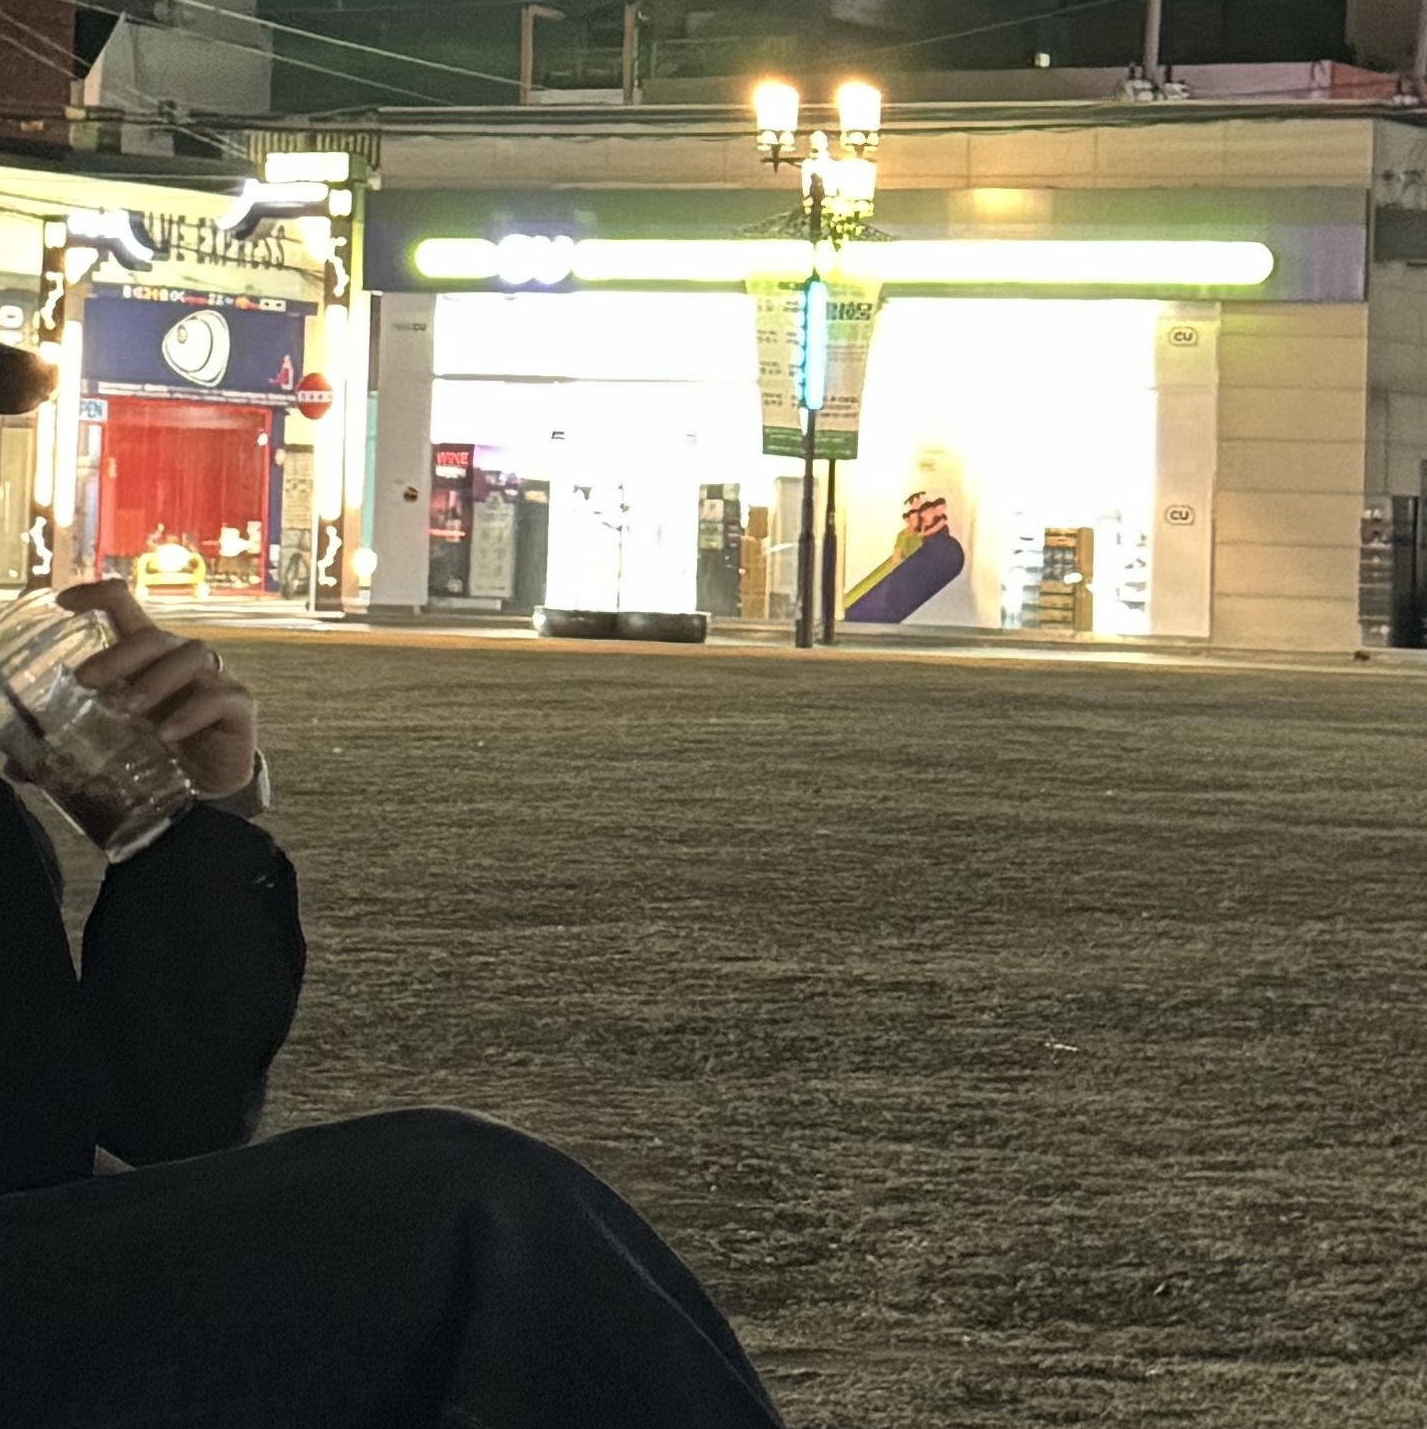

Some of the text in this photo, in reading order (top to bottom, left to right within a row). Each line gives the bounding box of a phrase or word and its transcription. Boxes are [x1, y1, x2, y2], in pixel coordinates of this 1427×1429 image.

[1173, 330, 1193, 342] CU
[436, 452, 469, 465] WINE
[1171, 509, 1190, 521] CU
